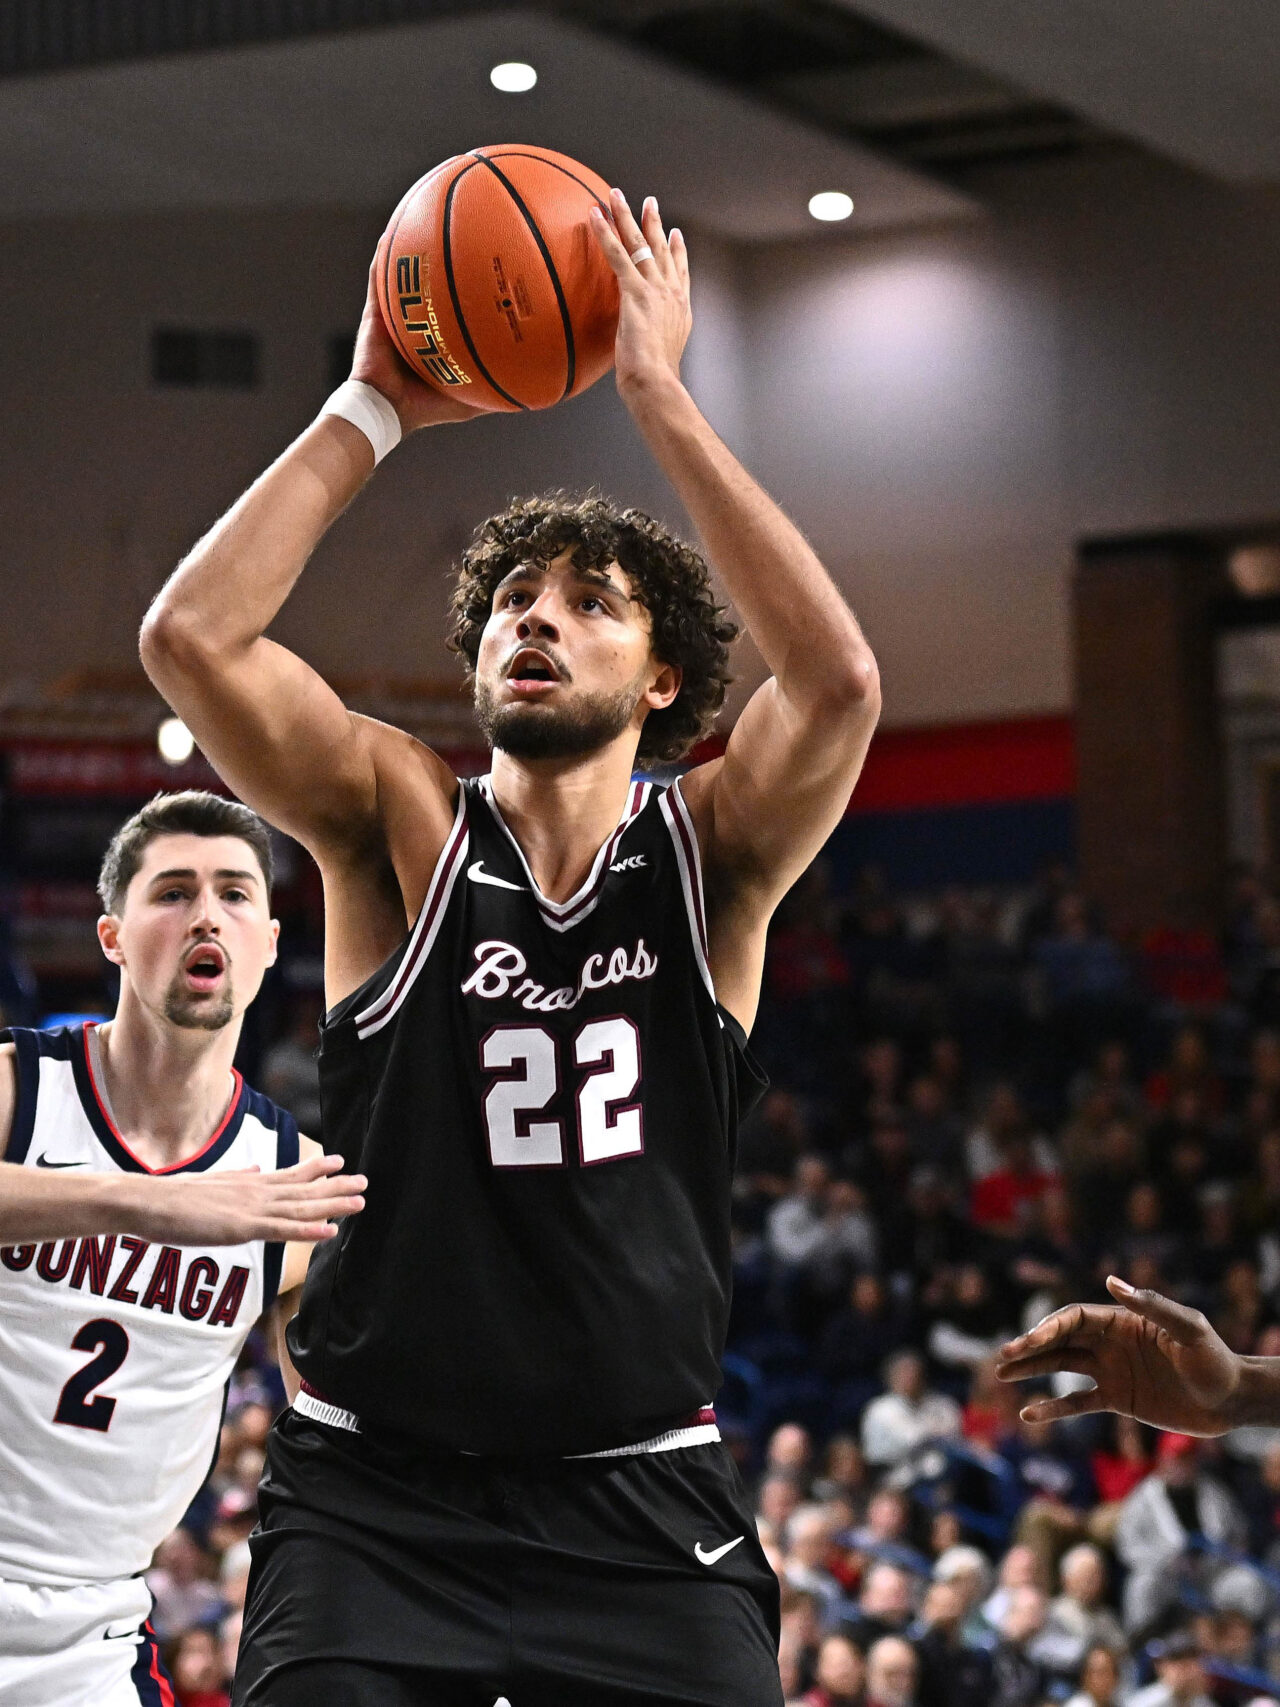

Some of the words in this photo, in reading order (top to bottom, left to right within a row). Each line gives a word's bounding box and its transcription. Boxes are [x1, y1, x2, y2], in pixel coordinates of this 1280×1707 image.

[396, 254, 464, 387] ELITE
[421, 253, 473, 385] CHAMPIONS
[609, 854, 648, 872] WCC
[461, 938, 659, 1012] Brocos
[479, 1013, 645, 1170] 22
[53, 1318, 130, 1432] 2
